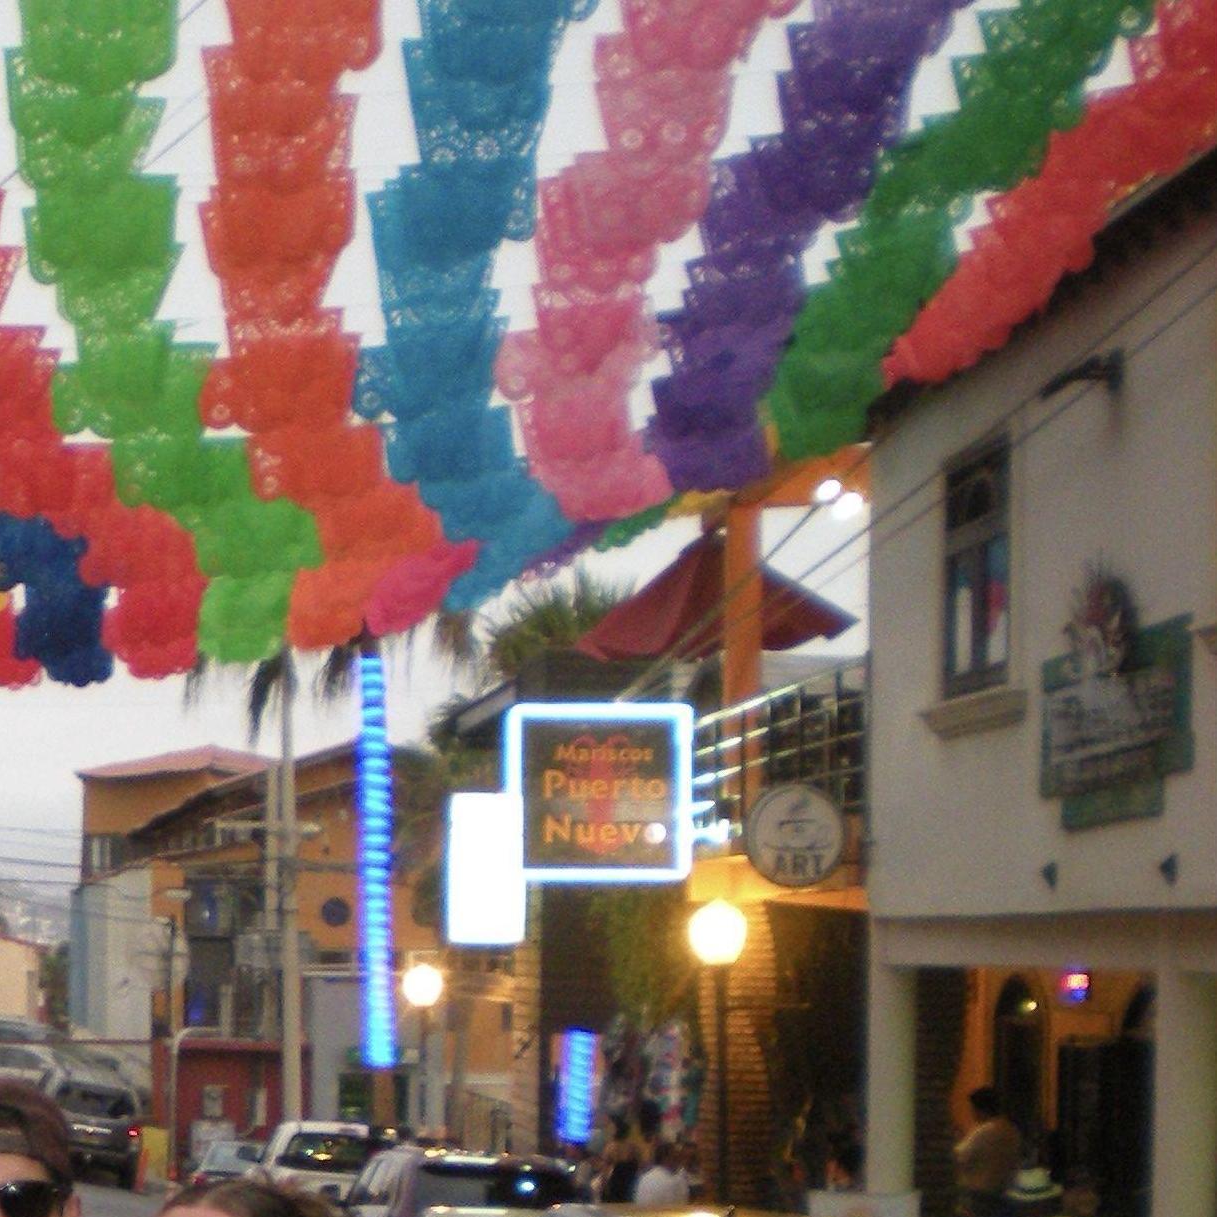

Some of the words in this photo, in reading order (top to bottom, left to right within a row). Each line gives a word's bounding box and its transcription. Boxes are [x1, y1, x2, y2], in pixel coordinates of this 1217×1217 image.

[554, 744, 654, 763] Mariscos
[542, 769, 667, 799] Puerto
[542, 813, 667, 845] Nuev
